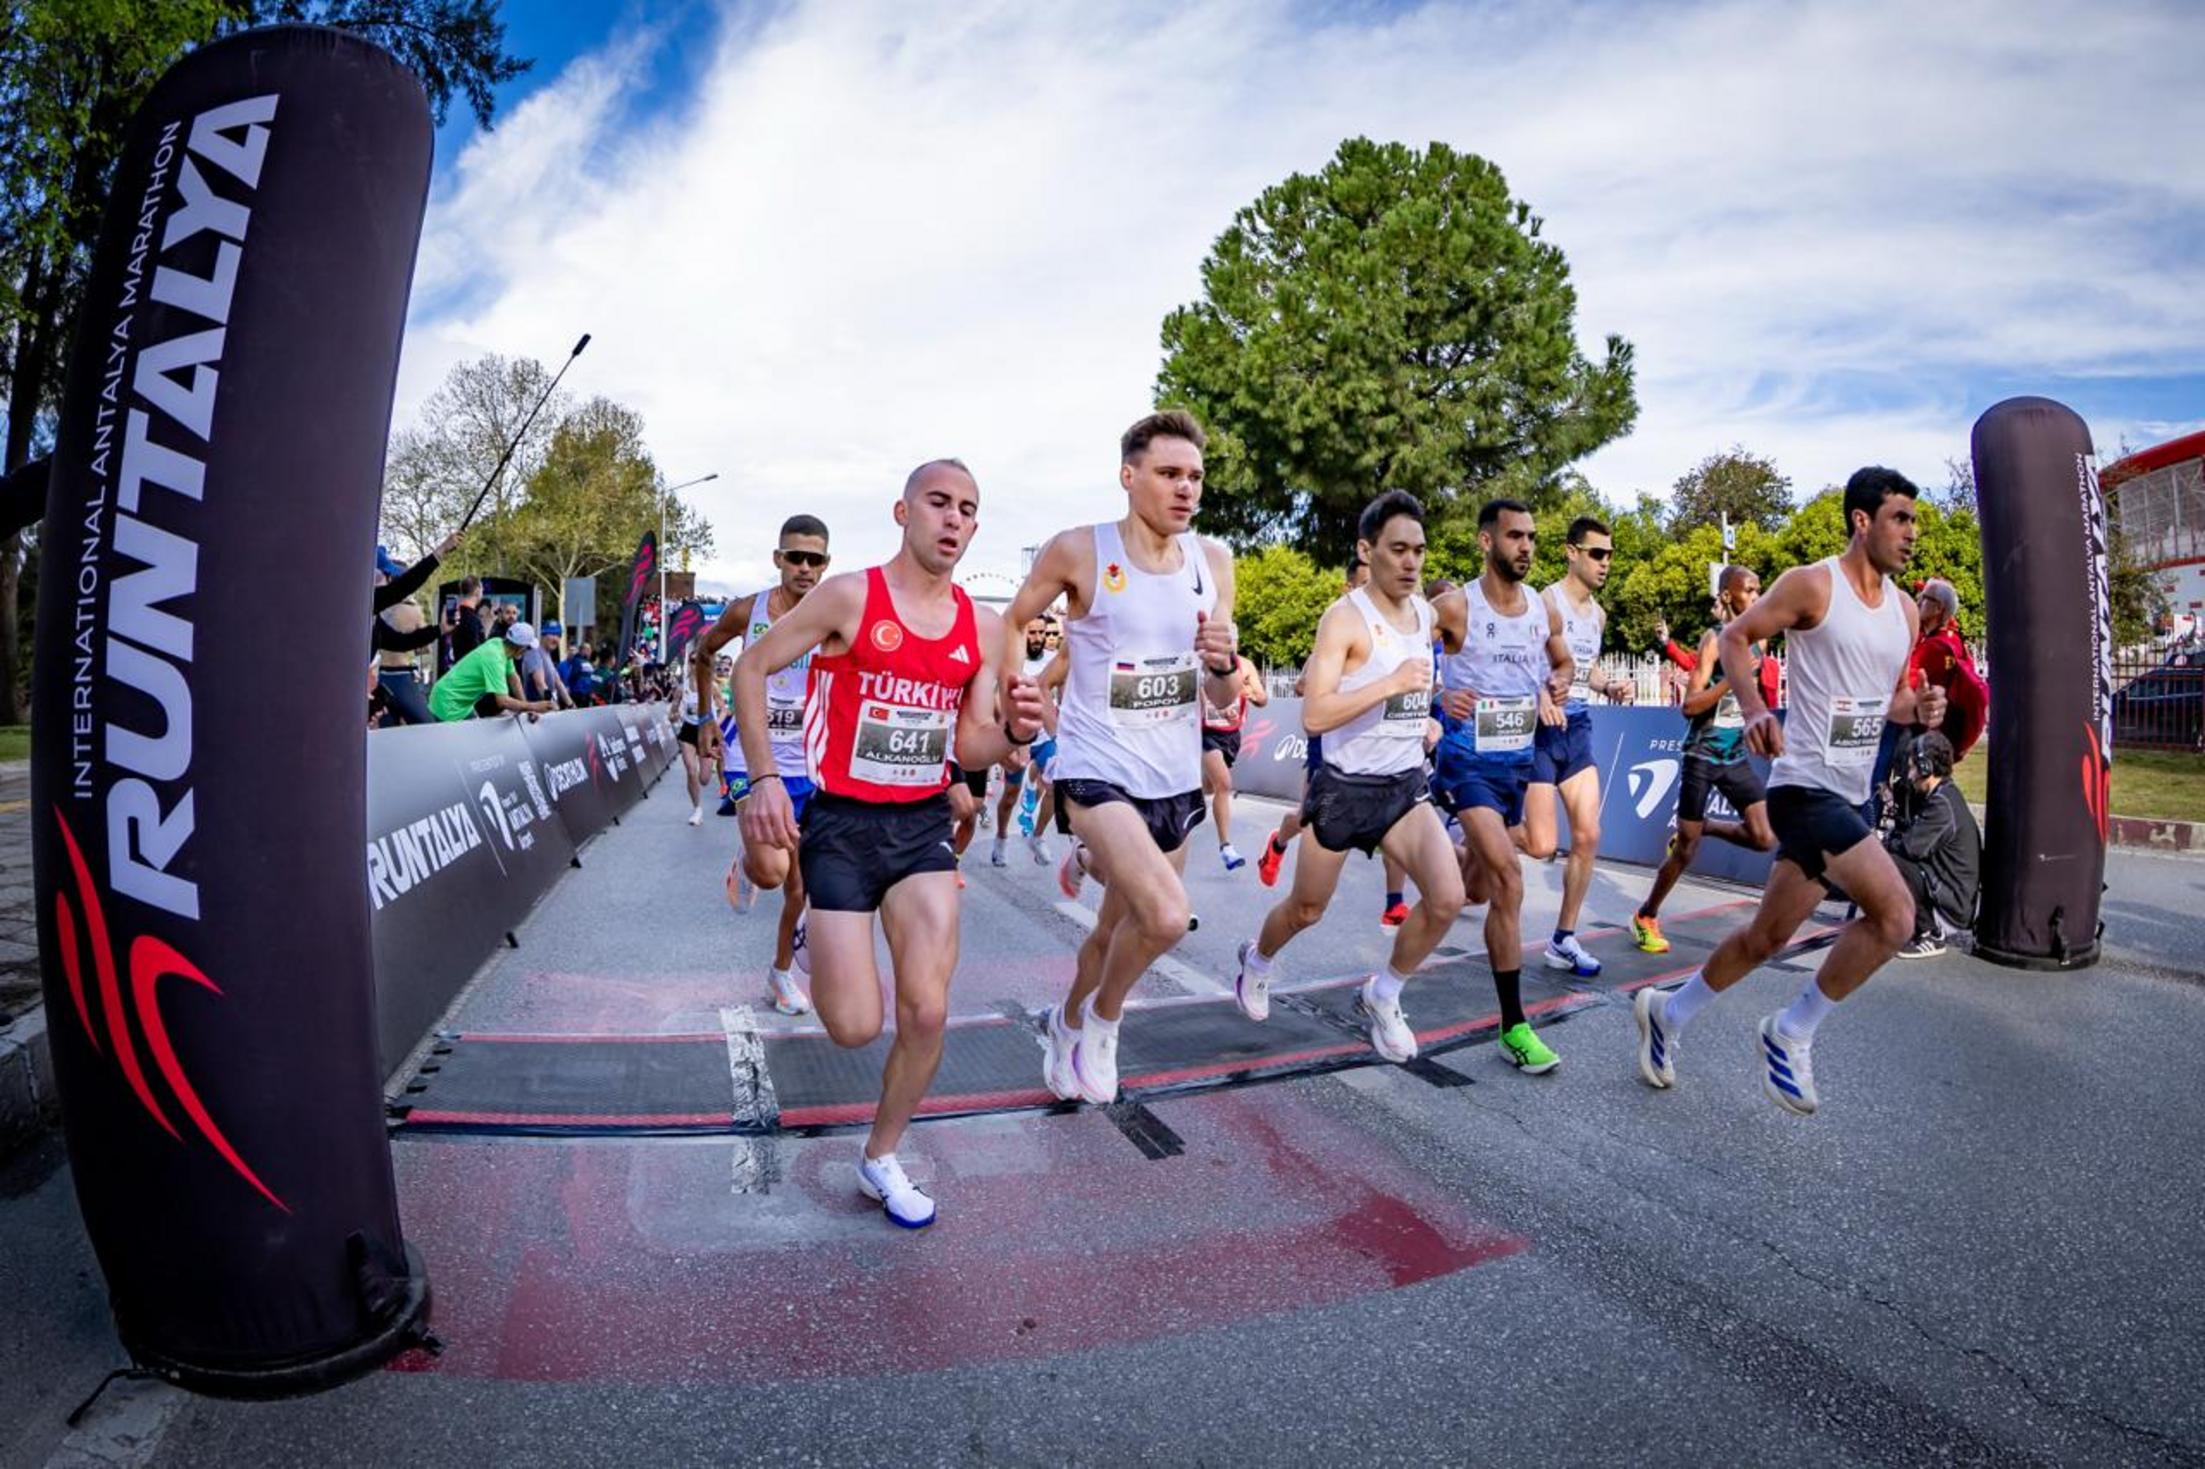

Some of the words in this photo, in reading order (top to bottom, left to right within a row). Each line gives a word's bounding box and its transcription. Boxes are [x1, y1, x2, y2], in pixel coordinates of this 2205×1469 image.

[74, 484, 107, 799] INTERNATIONAL
[91, 314, 134, 477] ANTALYA
[118, 120, 182, 308] MARATHON
[106, 93, 280, 921] RUNTALYA
[2075, 452, 2091, 535] MARATHON
[2085, 538, 2097, 602] ANTALYA
[1492, 654, 1530, 665] ITALIA
[2089, 605, 2101, 721] INTERNATIONAL
[858, 669, 963, 711] TÜRKİY
[1133, 696, 1181, 709] POPOV
[1138, 675, 1179, 699] 603
[1496, 711, 1524, 729] 546
[1851, 717, 1882, 738] 565
[889, 729, 931, 754] 641
[367, 801, 482, 911] RUNTALYA
